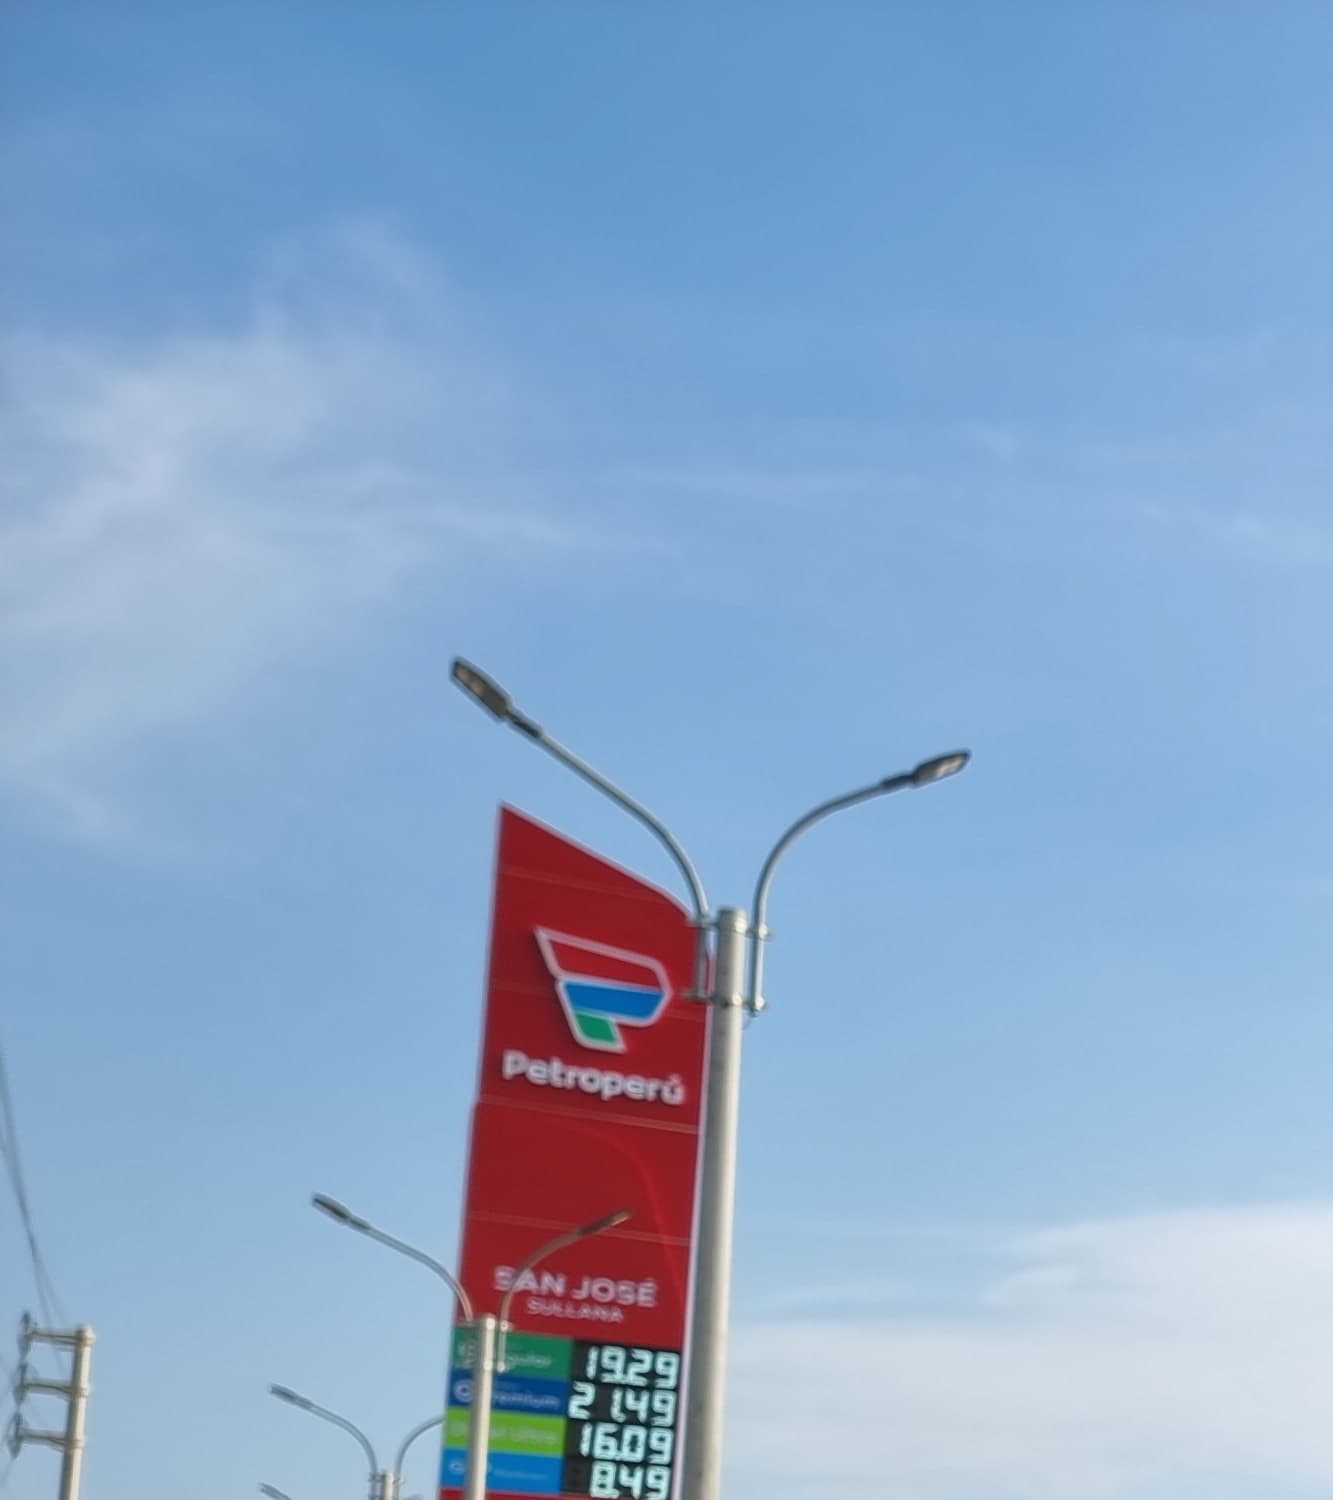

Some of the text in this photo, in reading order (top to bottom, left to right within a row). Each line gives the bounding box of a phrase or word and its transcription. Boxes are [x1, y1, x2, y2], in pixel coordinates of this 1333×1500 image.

[503, 1050, 685, 1105] Petroperú
[494, 1265, 657, 1308] SAN JOSÉ
[528, 1297, 624, 1323] SULLANA
